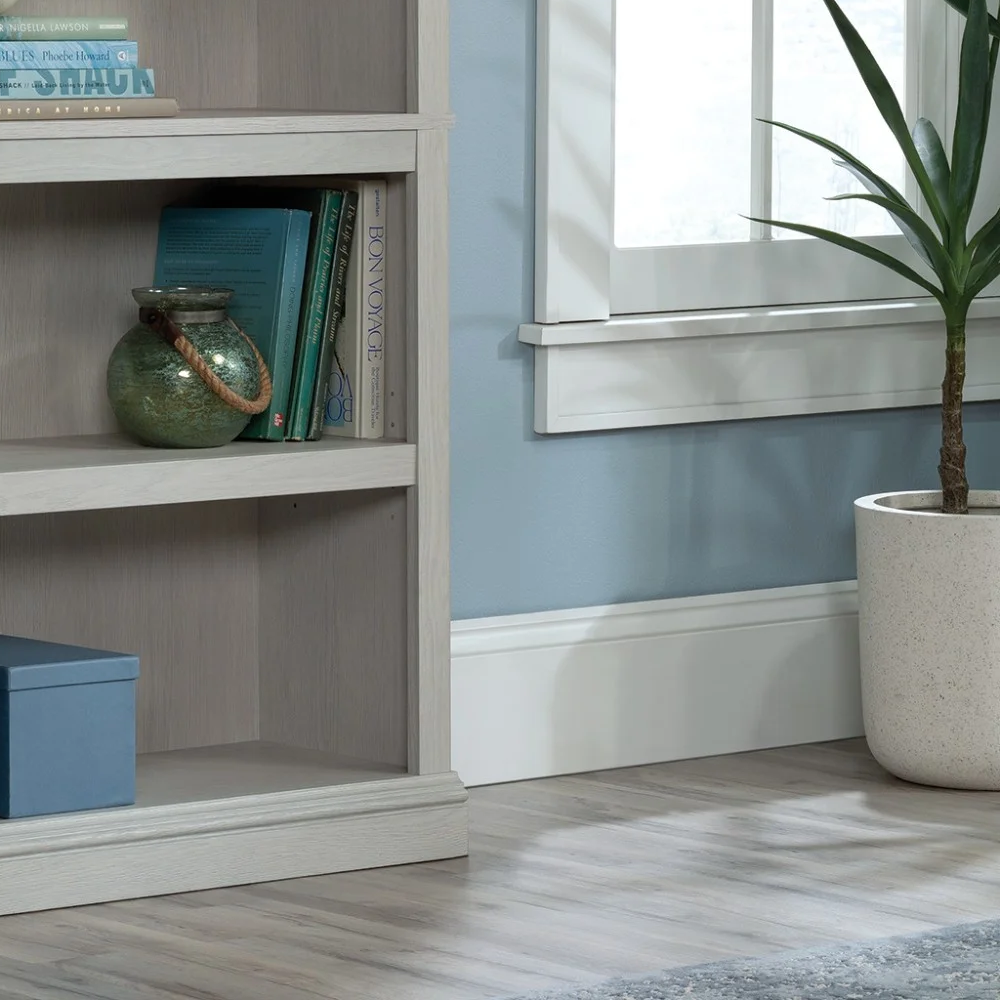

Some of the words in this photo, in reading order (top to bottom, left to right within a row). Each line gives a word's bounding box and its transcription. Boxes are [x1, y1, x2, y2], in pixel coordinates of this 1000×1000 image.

[9, 23, 46, 32] NIGELLA
[50, 23, 89, 32] LAWSON
[42, 50, 74, 62] Phoebe
[75, 50, 110, 61] Howard
[33, 69, 155, 96] SHACK
[83, 105, 121, 113] HOME
[330, 207, 338, 225] The
[347, 204, 356, 221] The
[326, 227, 336, 244] Life
[342, 224, 353, 241] Life
[323, 246, 331, 257] of
[340, 244, 349, 257] of
[368, 226, 384, 272] BON
[319, 259, 330, 293] Prairies
[337, 258, 347, 285] Rivers
[315, 295, 323, 315] and
[334, 288, 342, 306] and
[329, 308, 340, 342] Streams
[367, 278, 384, 362] VOYAGE
